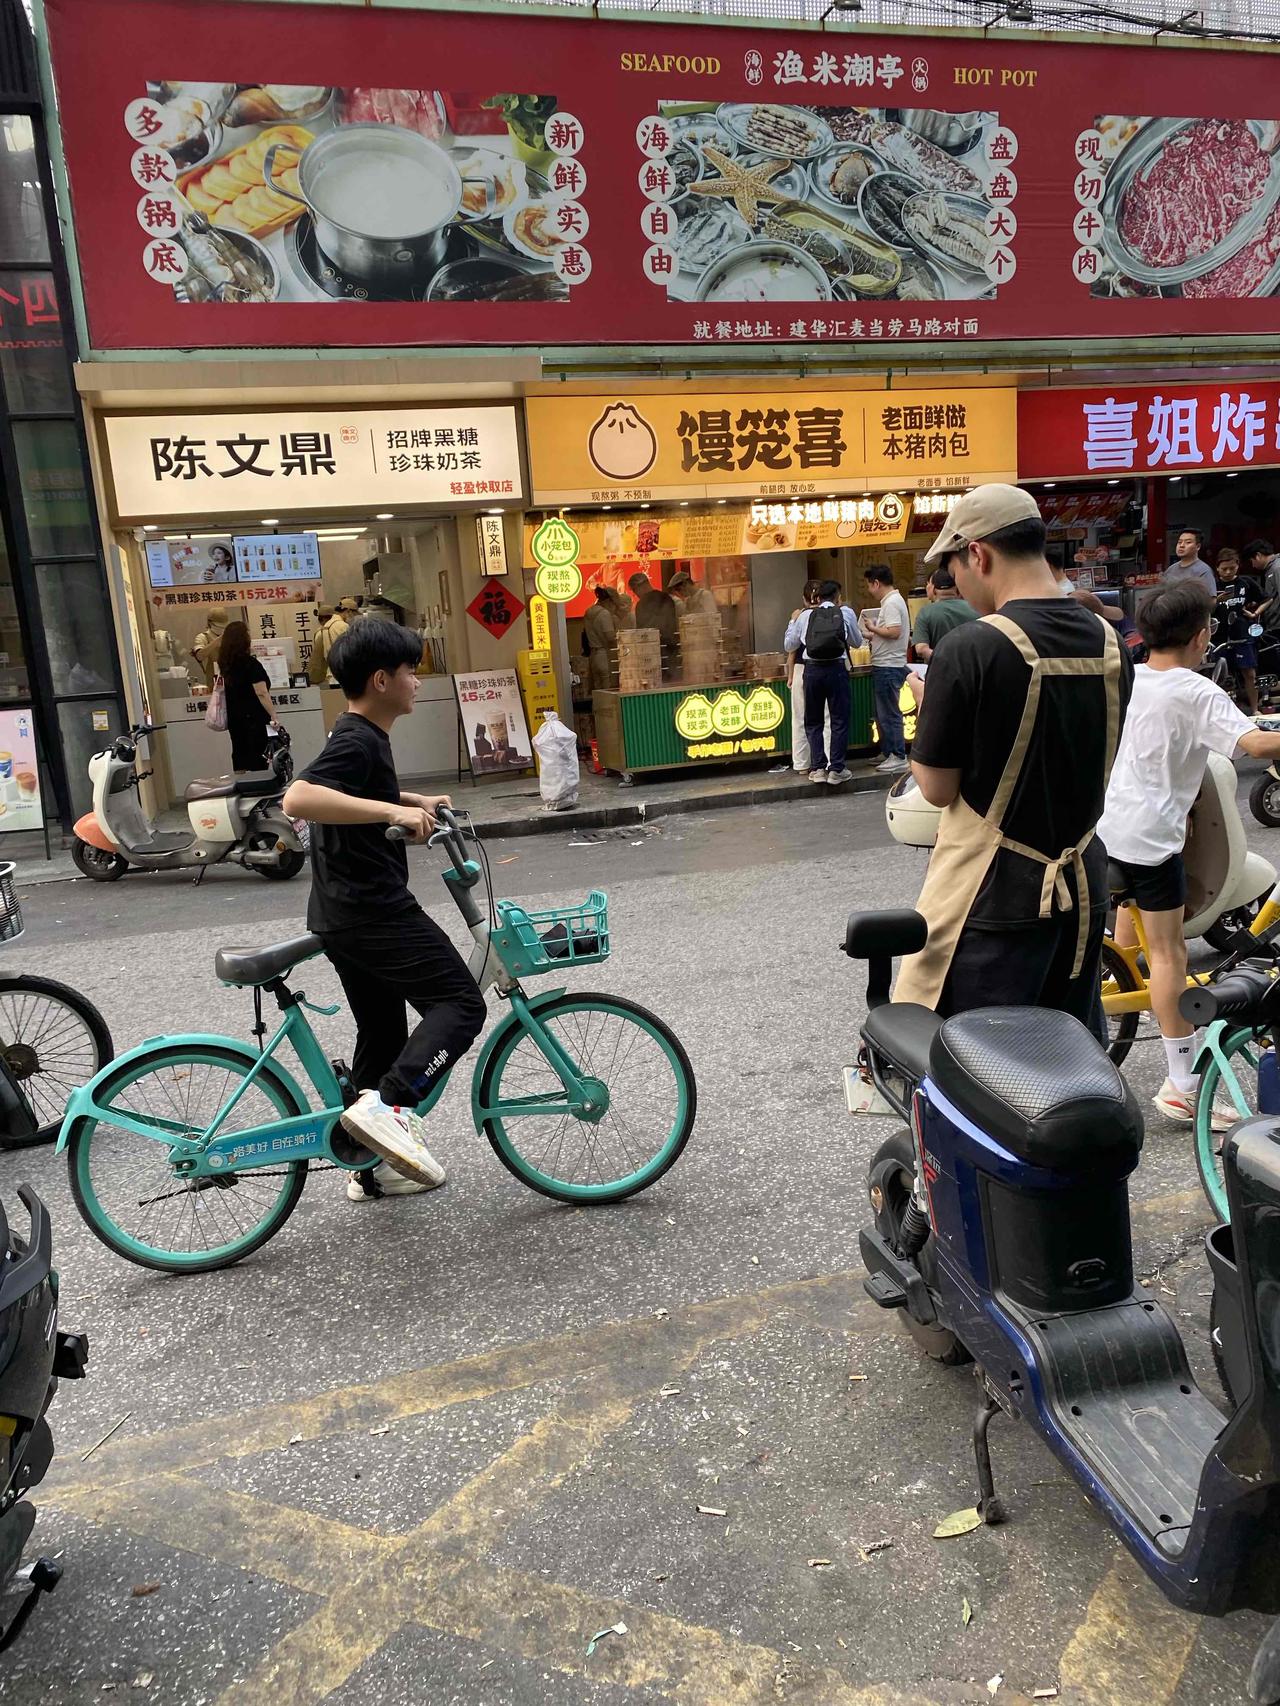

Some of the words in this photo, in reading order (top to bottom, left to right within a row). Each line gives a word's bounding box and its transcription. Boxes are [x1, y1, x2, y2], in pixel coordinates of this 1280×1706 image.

[620, 52, 721, 75] SEAFOOD
[746, 52, 762, 83] 海鲜
[772, 49, 905, 89] 渔米潮亭
[913, 58, 928, 91] 火锅
[953, 67, 994, 86] HOT
[1000, 69, 1038, 87] POT
[137, 104, 184, 276] 多款锅底
[549, 119, 587, 277] 新鲜实惠
[641, 121, 674, 277] 海鲜自由
[988, 133, 1016, 277] 盘盘大个
[1076, 135, 1103, 277] 现切牛肉
[881, 404, 967, 431] 老面鲜做
[1083, 391, 1280, 470] 喜姐炸
[387, 427, 479, 449] 招牌黑糖
[676, 407, 847, 473] 馒笼喜
[882, 432, 970, 461] 本猪肉包
[150, 433, 336, 481] 陈文鼎
[389, 450, 482, 472] 珍珠奶茶
[450, 480, 513, 495] 轻盈快取店
[486, 520, 502, 558] 陈文鼎
[541, 541, 572, 552] 小笼包
[480, 591, 511, 624] 福
[535, 602, 547, 649] 黄金玉米
[460, 675, 516, 691] 黑糖珍珠奶茶
